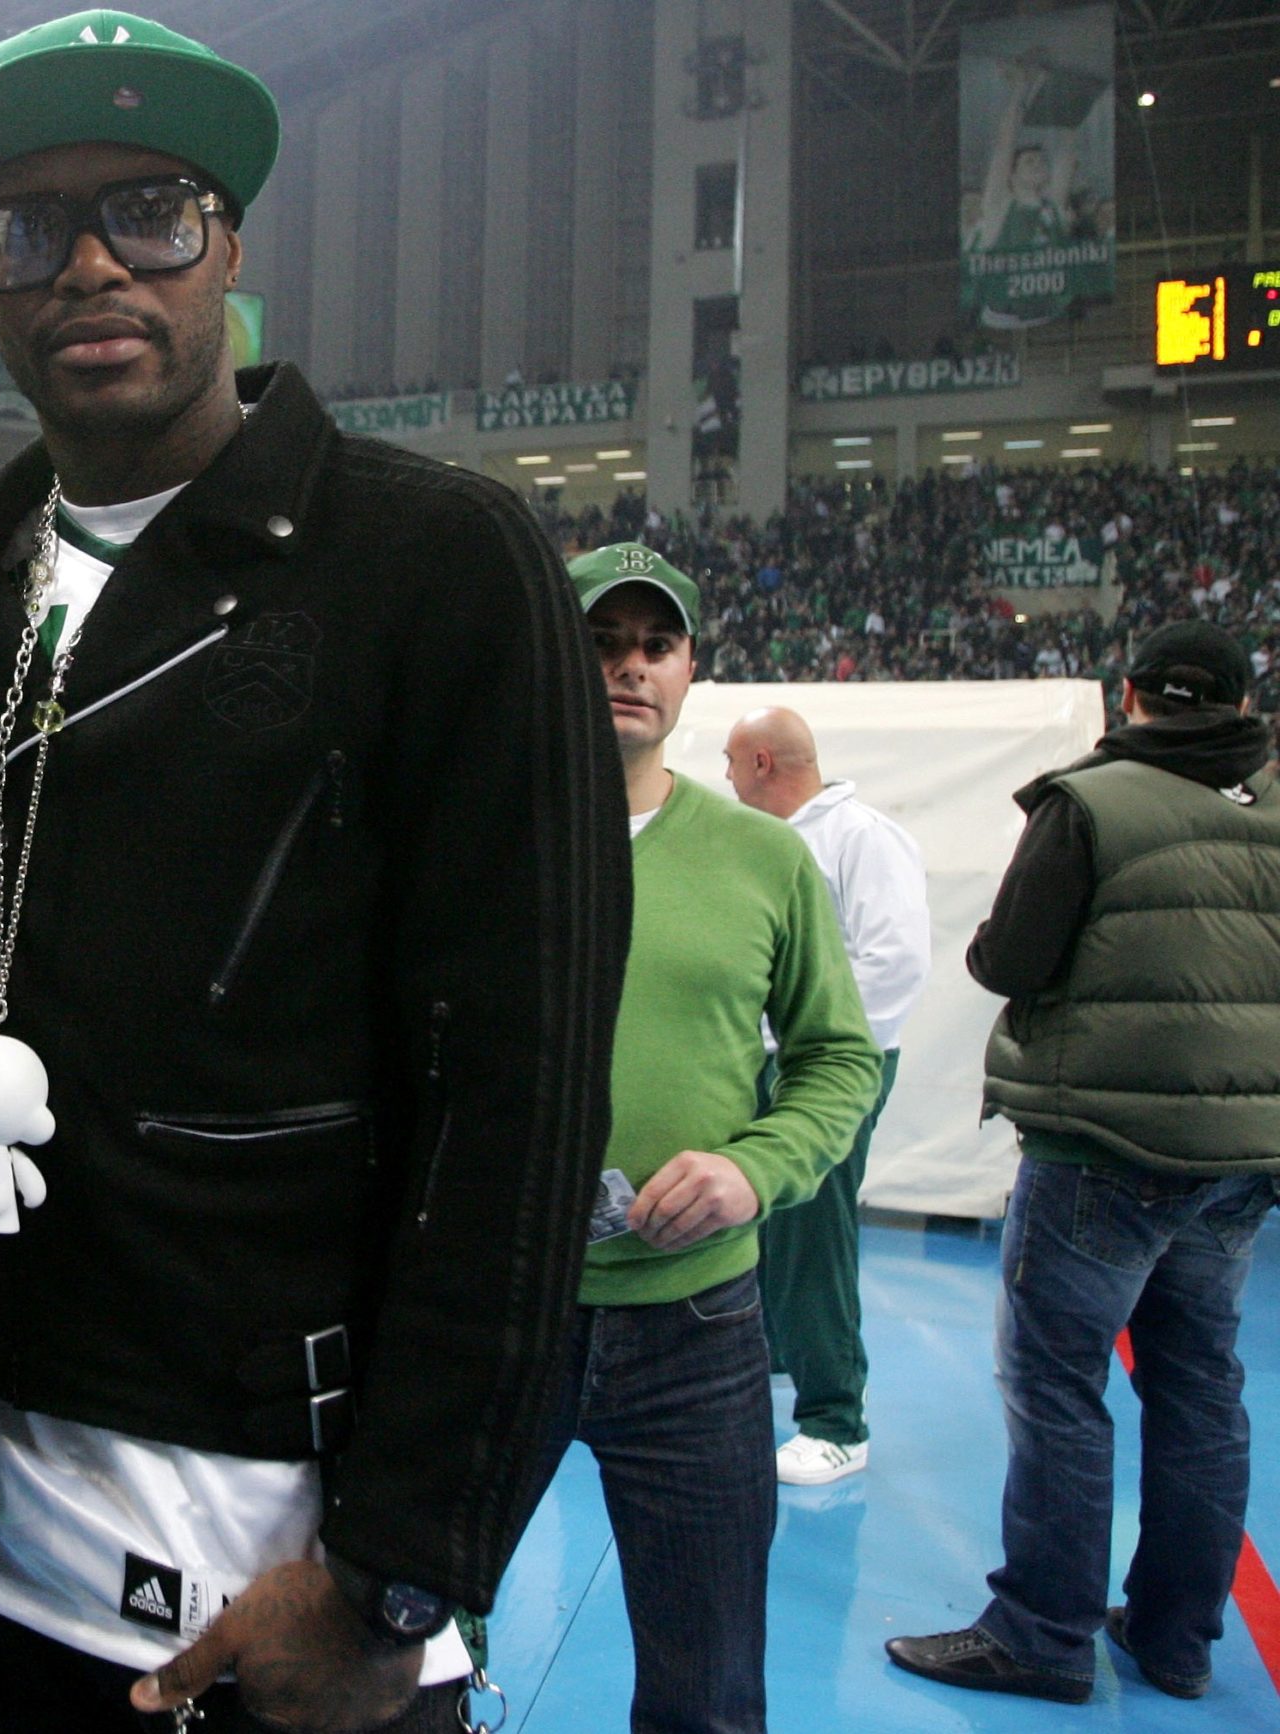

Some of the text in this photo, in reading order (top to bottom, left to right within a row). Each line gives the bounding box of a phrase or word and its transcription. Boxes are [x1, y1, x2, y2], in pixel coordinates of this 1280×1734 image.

[970, 242, 1108, 275] Thessaloniki
[1008, 271, 1065, 297] 2000
[129, 1593, 173, 1619] adidas
[189, 1582, 199, 1622] TEAM
